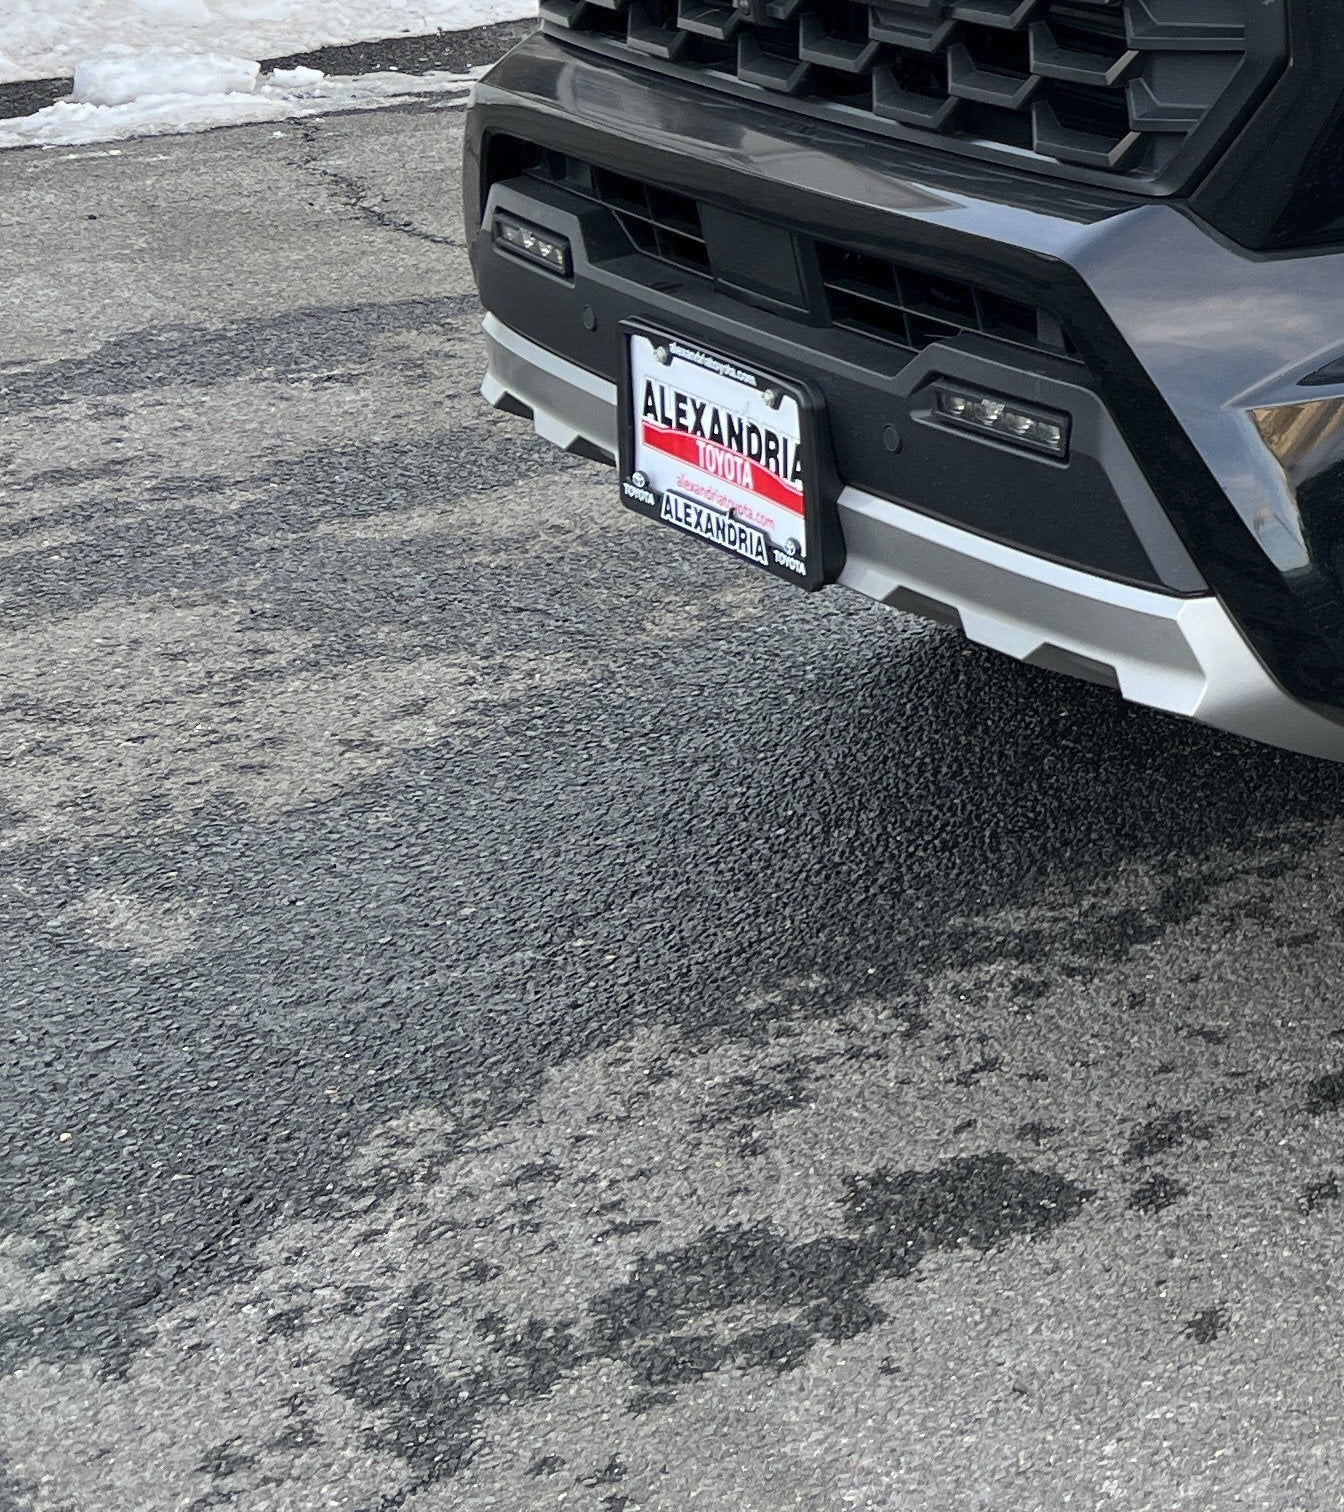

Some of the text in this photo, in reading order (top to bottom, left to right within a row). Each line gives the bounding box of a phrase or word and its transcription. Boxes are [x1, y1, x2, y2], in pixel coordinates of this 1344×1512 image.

[642, 378, 802, 484] ALEXANDRIA
[695, 439, 755, 490] TOYOTA
[623, 482, 655, 506] TOYOTA
[663, 493, 769, 565] ALEXANDRIA
[773, 549, 807, 576] TOYOTA
